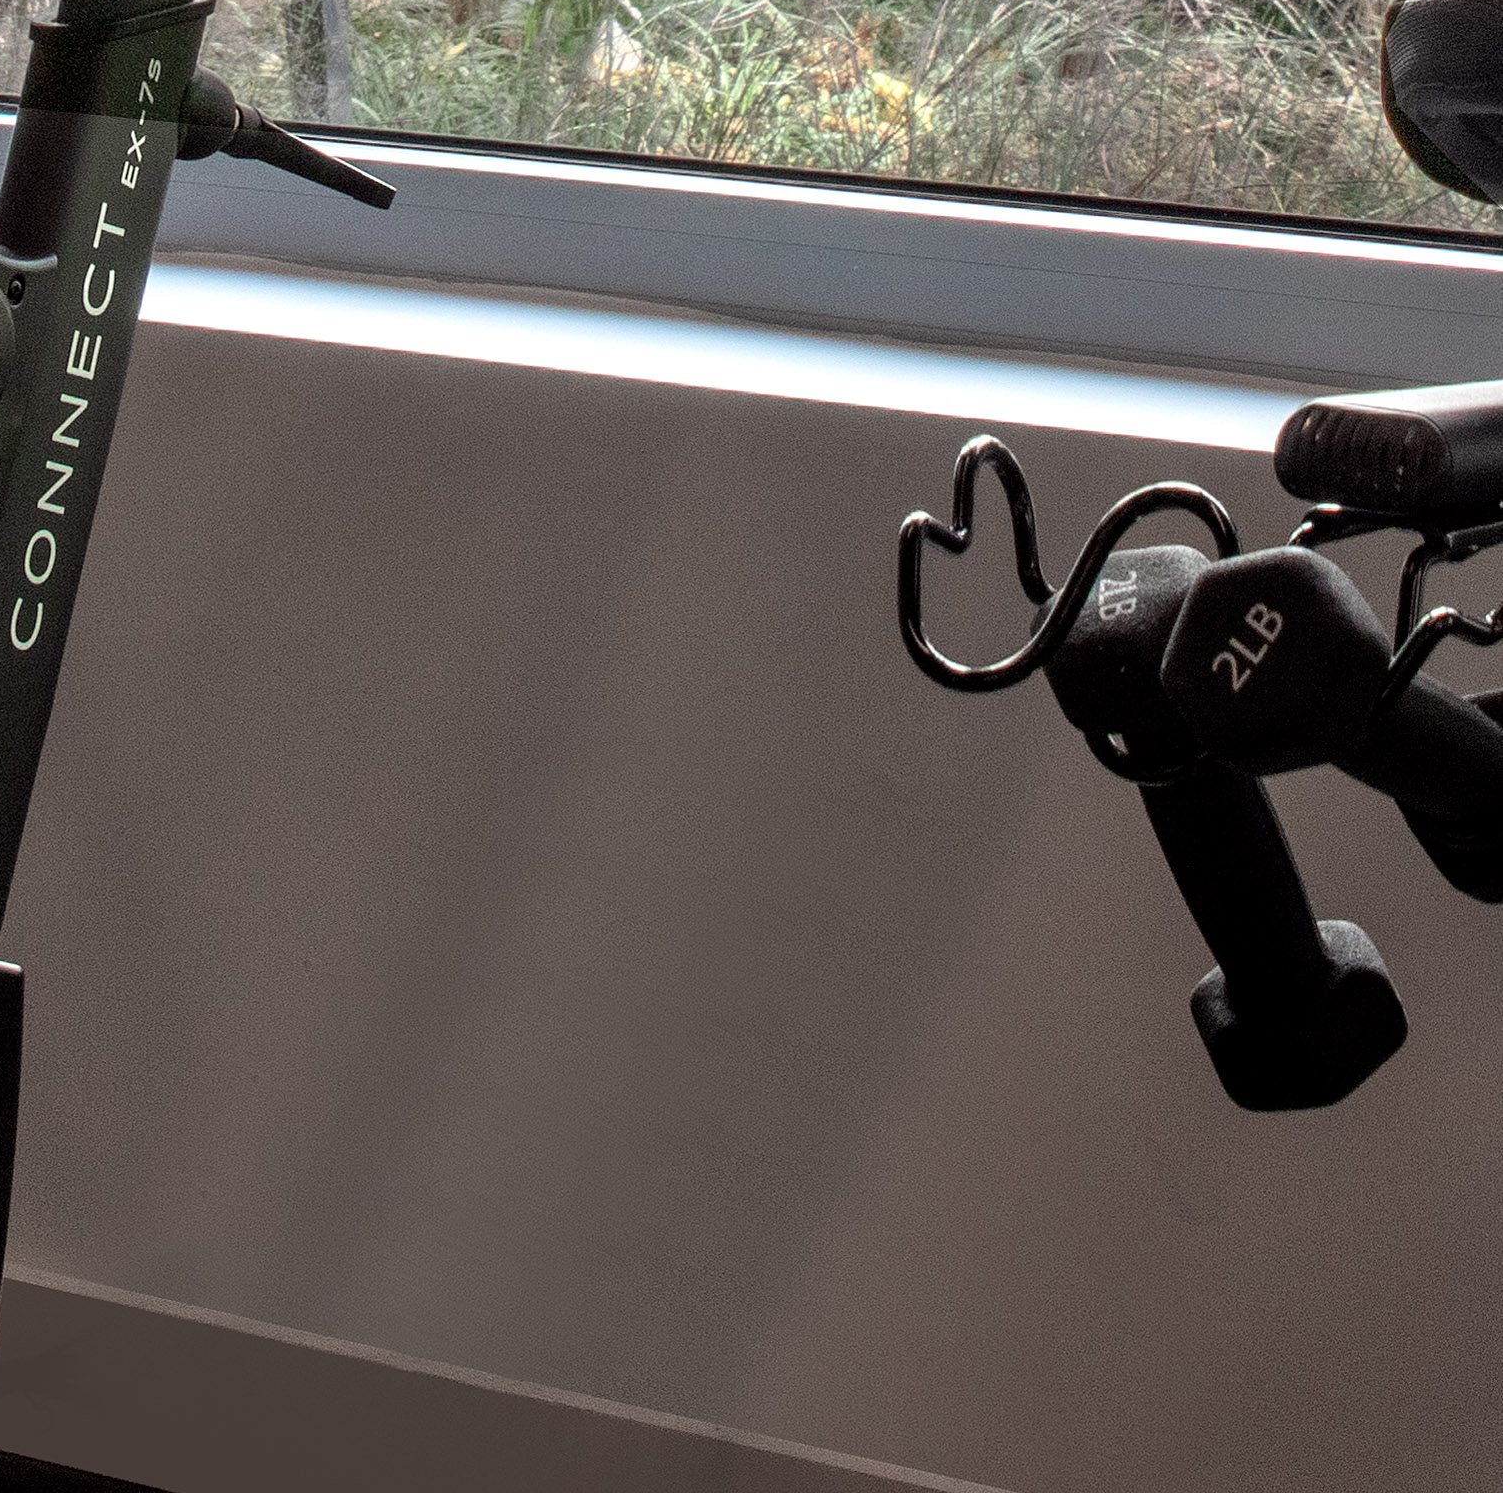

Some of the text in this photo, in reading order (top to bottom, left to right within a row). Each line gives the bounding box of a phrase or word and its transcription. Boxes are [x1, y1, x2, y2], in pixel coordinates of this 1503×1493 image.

[10, 202, 125, 651] CONNECT
[1098, 570, 1138, 621] 2LB
[1211, 602, 1284, 693] 2LB
